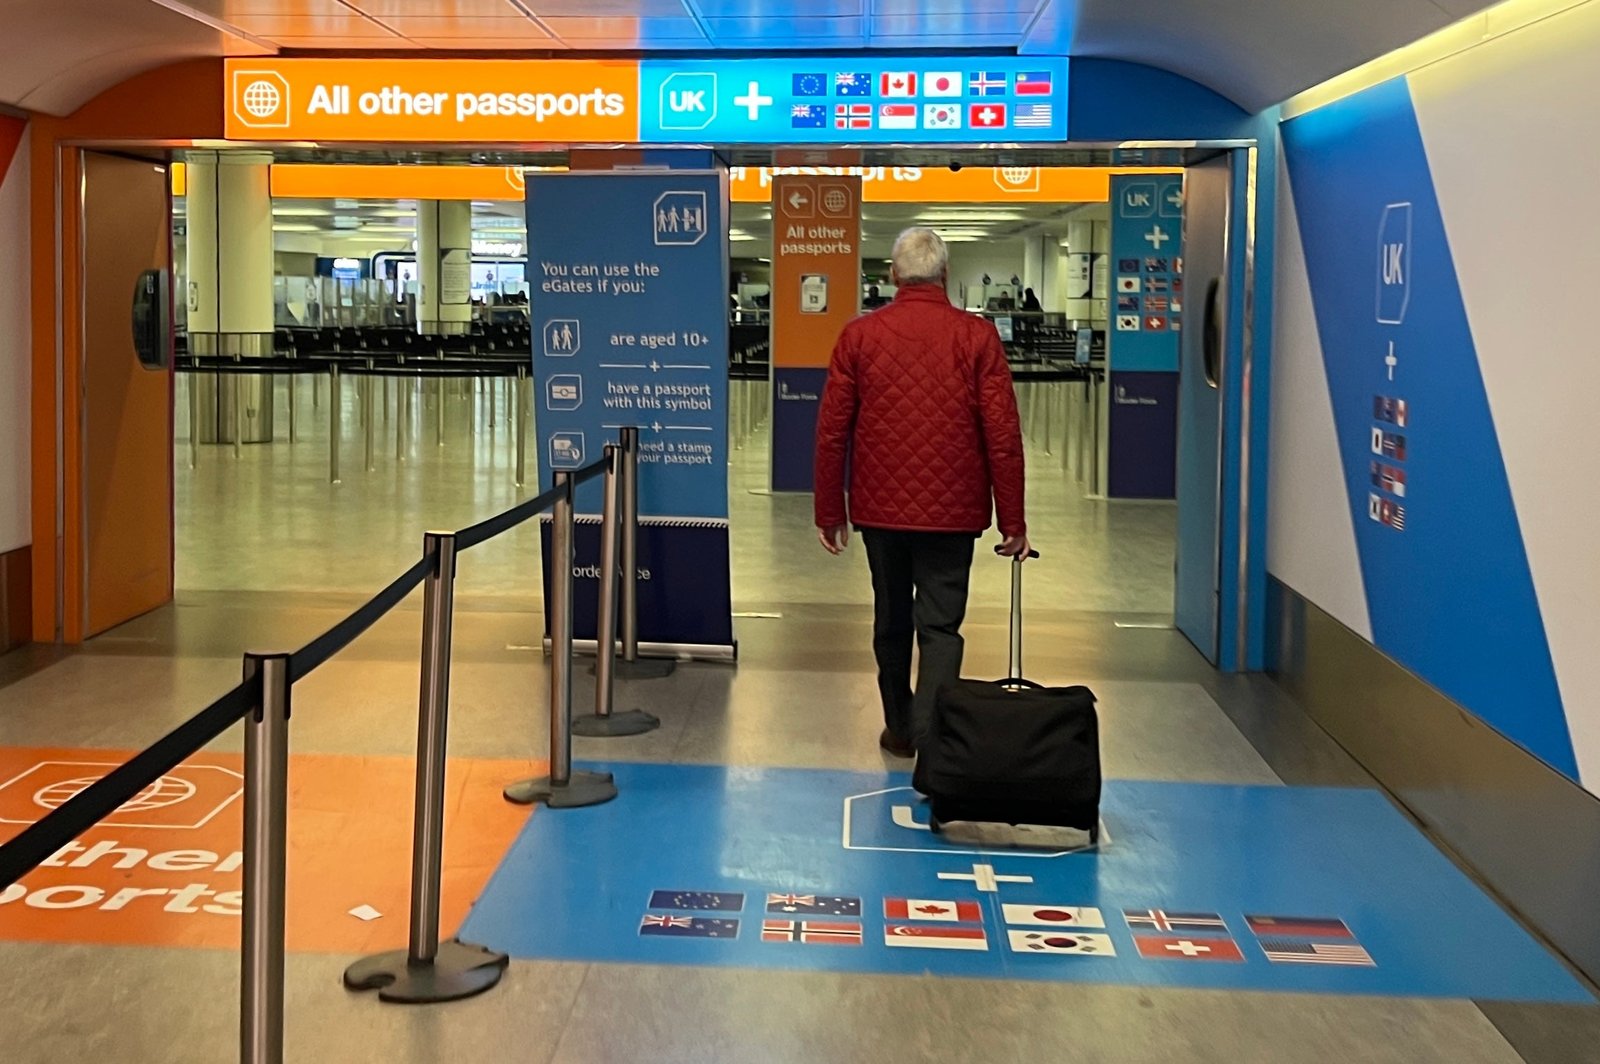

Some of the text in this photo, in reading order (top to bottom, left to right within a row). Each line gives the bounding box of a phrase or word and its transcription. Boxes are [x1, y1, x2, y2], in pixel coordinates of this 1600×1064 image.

[307, 85, 625, 122] All other passports
[669, 90, 706, 112] UK
[1127, 193, 1150, 207] UK
[786, 225, 846, 239] All other
[780, 242, 851, 256] passports
[541, 262, 660, 277] You can use the
[1383, 243, 1403, 285] UK
[542, 280, 645, 296] eGates if you:
[610, 331, 709, 350] are aged 10+
[607, 382, 711, 398] have a passport
[603, 397, 712, 412] with this symbol
[667, 443, 675, 452] a
[677, 442, 713, 456] stamp
[664, 454, 713, 466] passport
[572, 565, 601, 578] orde
[38, 840, 243, 871] ther
[0, 883, 243, 915] orts
